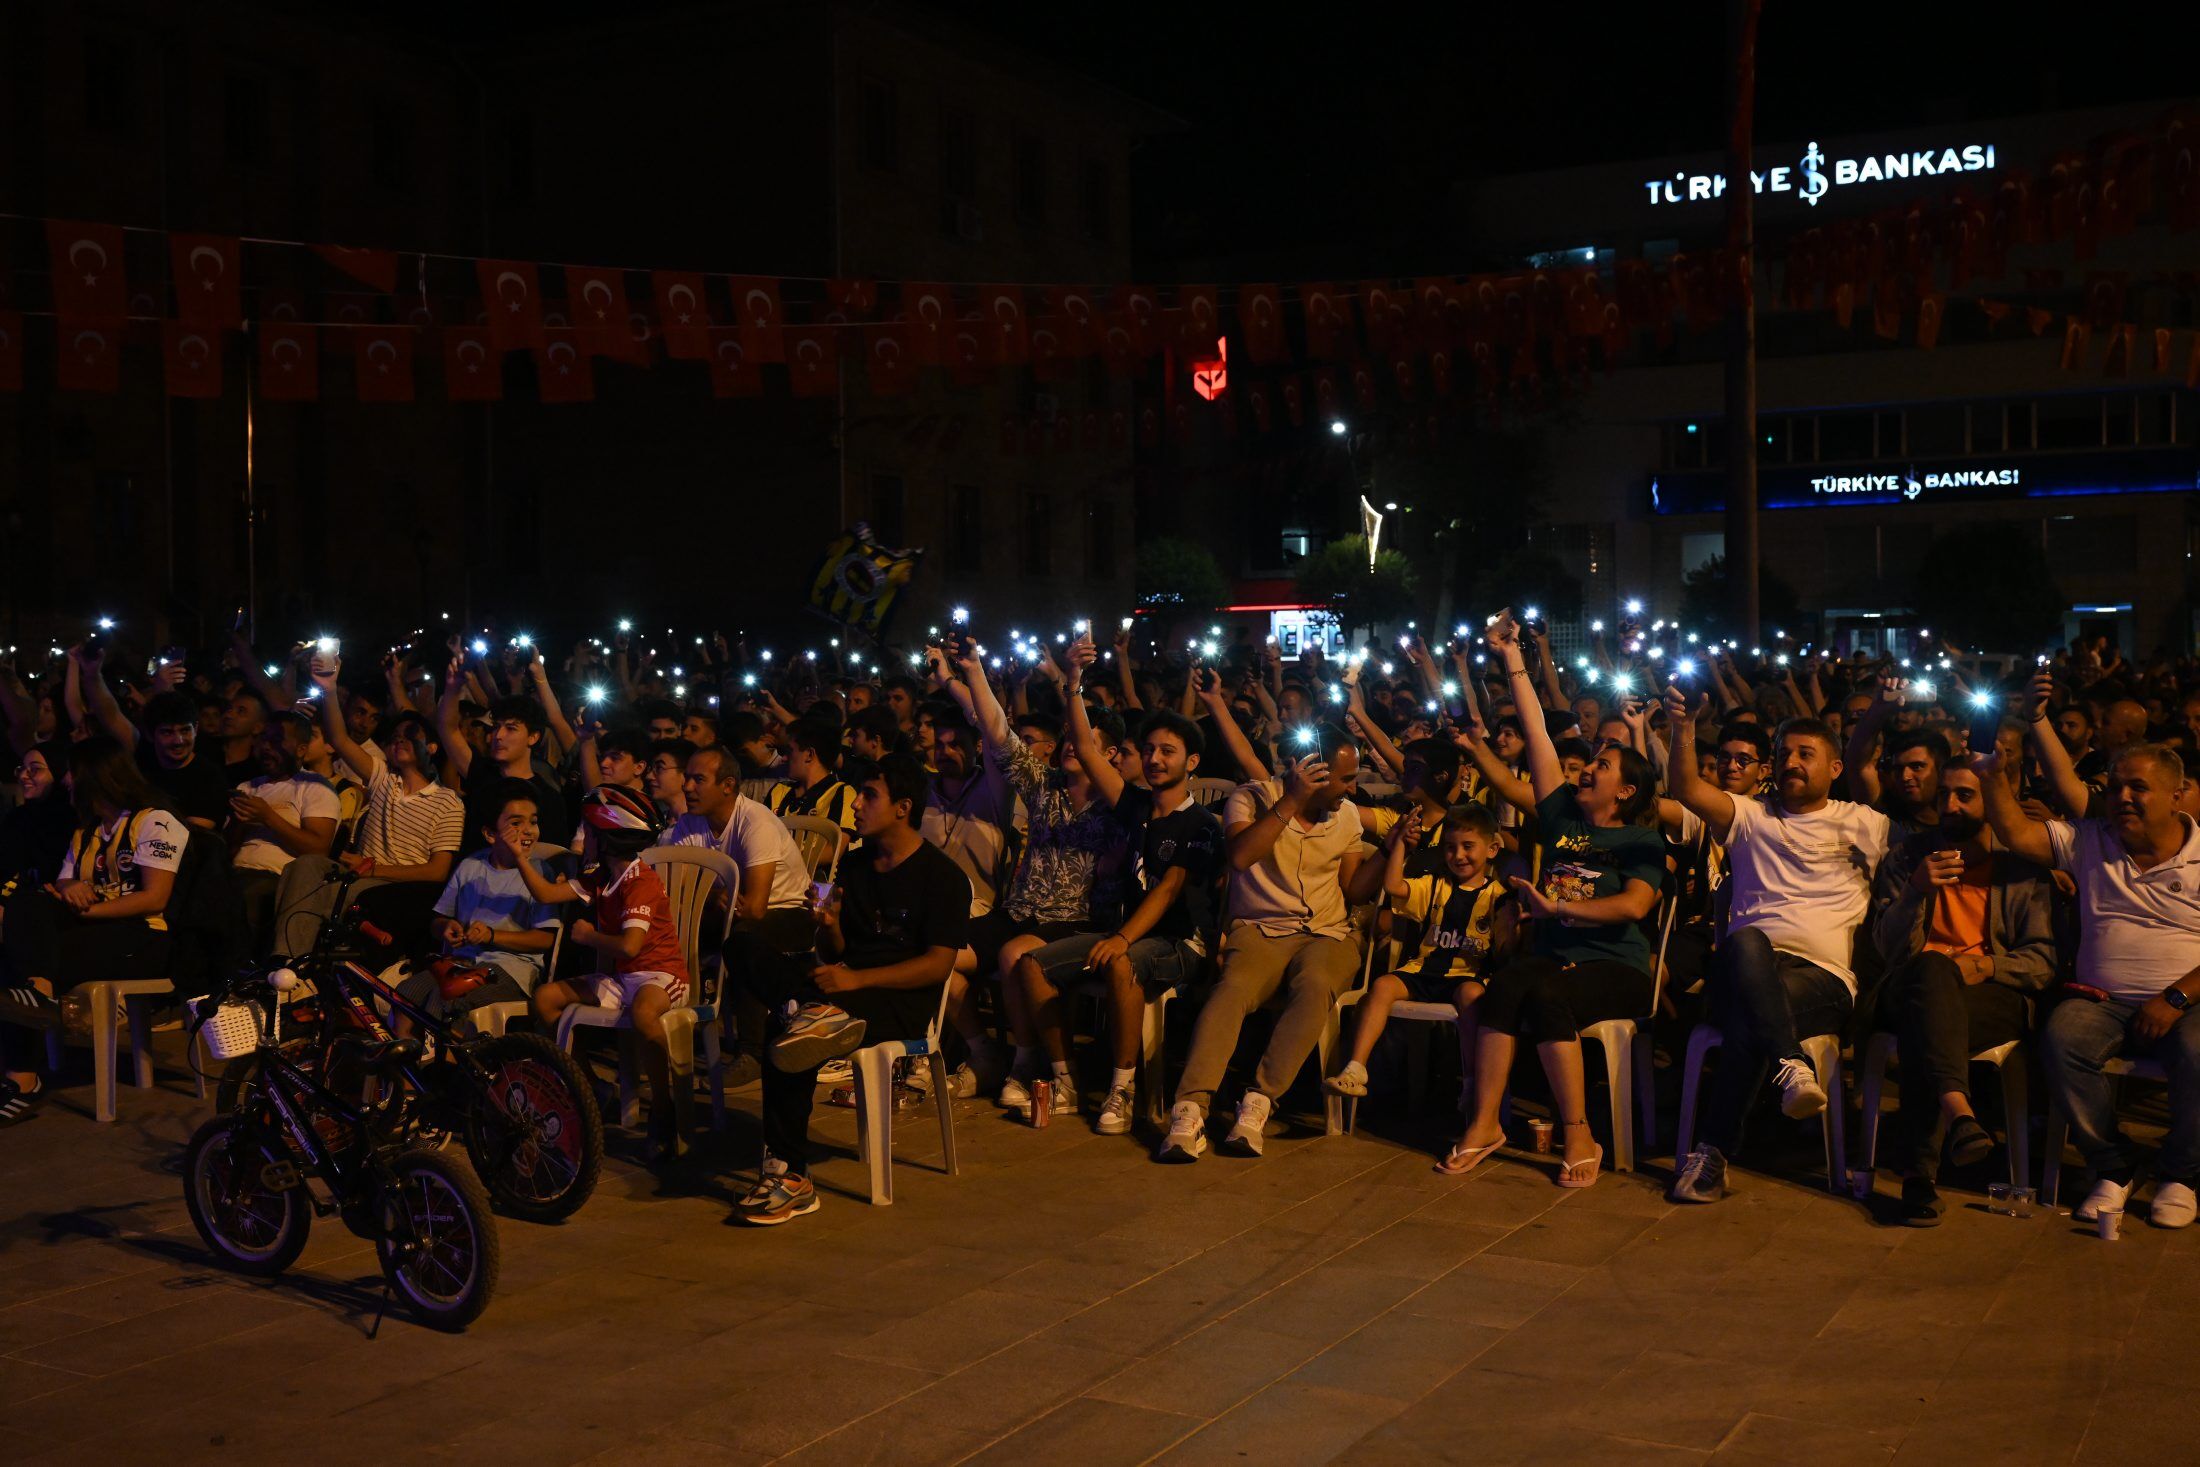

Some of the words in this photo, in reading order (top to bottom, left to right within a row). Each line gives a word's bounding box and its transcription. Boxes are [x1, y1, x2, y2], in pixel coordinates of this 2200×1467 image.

[1835, 144, 1995, 185] BANKASI
[1810, 473, 1900, 493] TÜRKİYE
[1925, 469, 2019, 488] BANKASI
